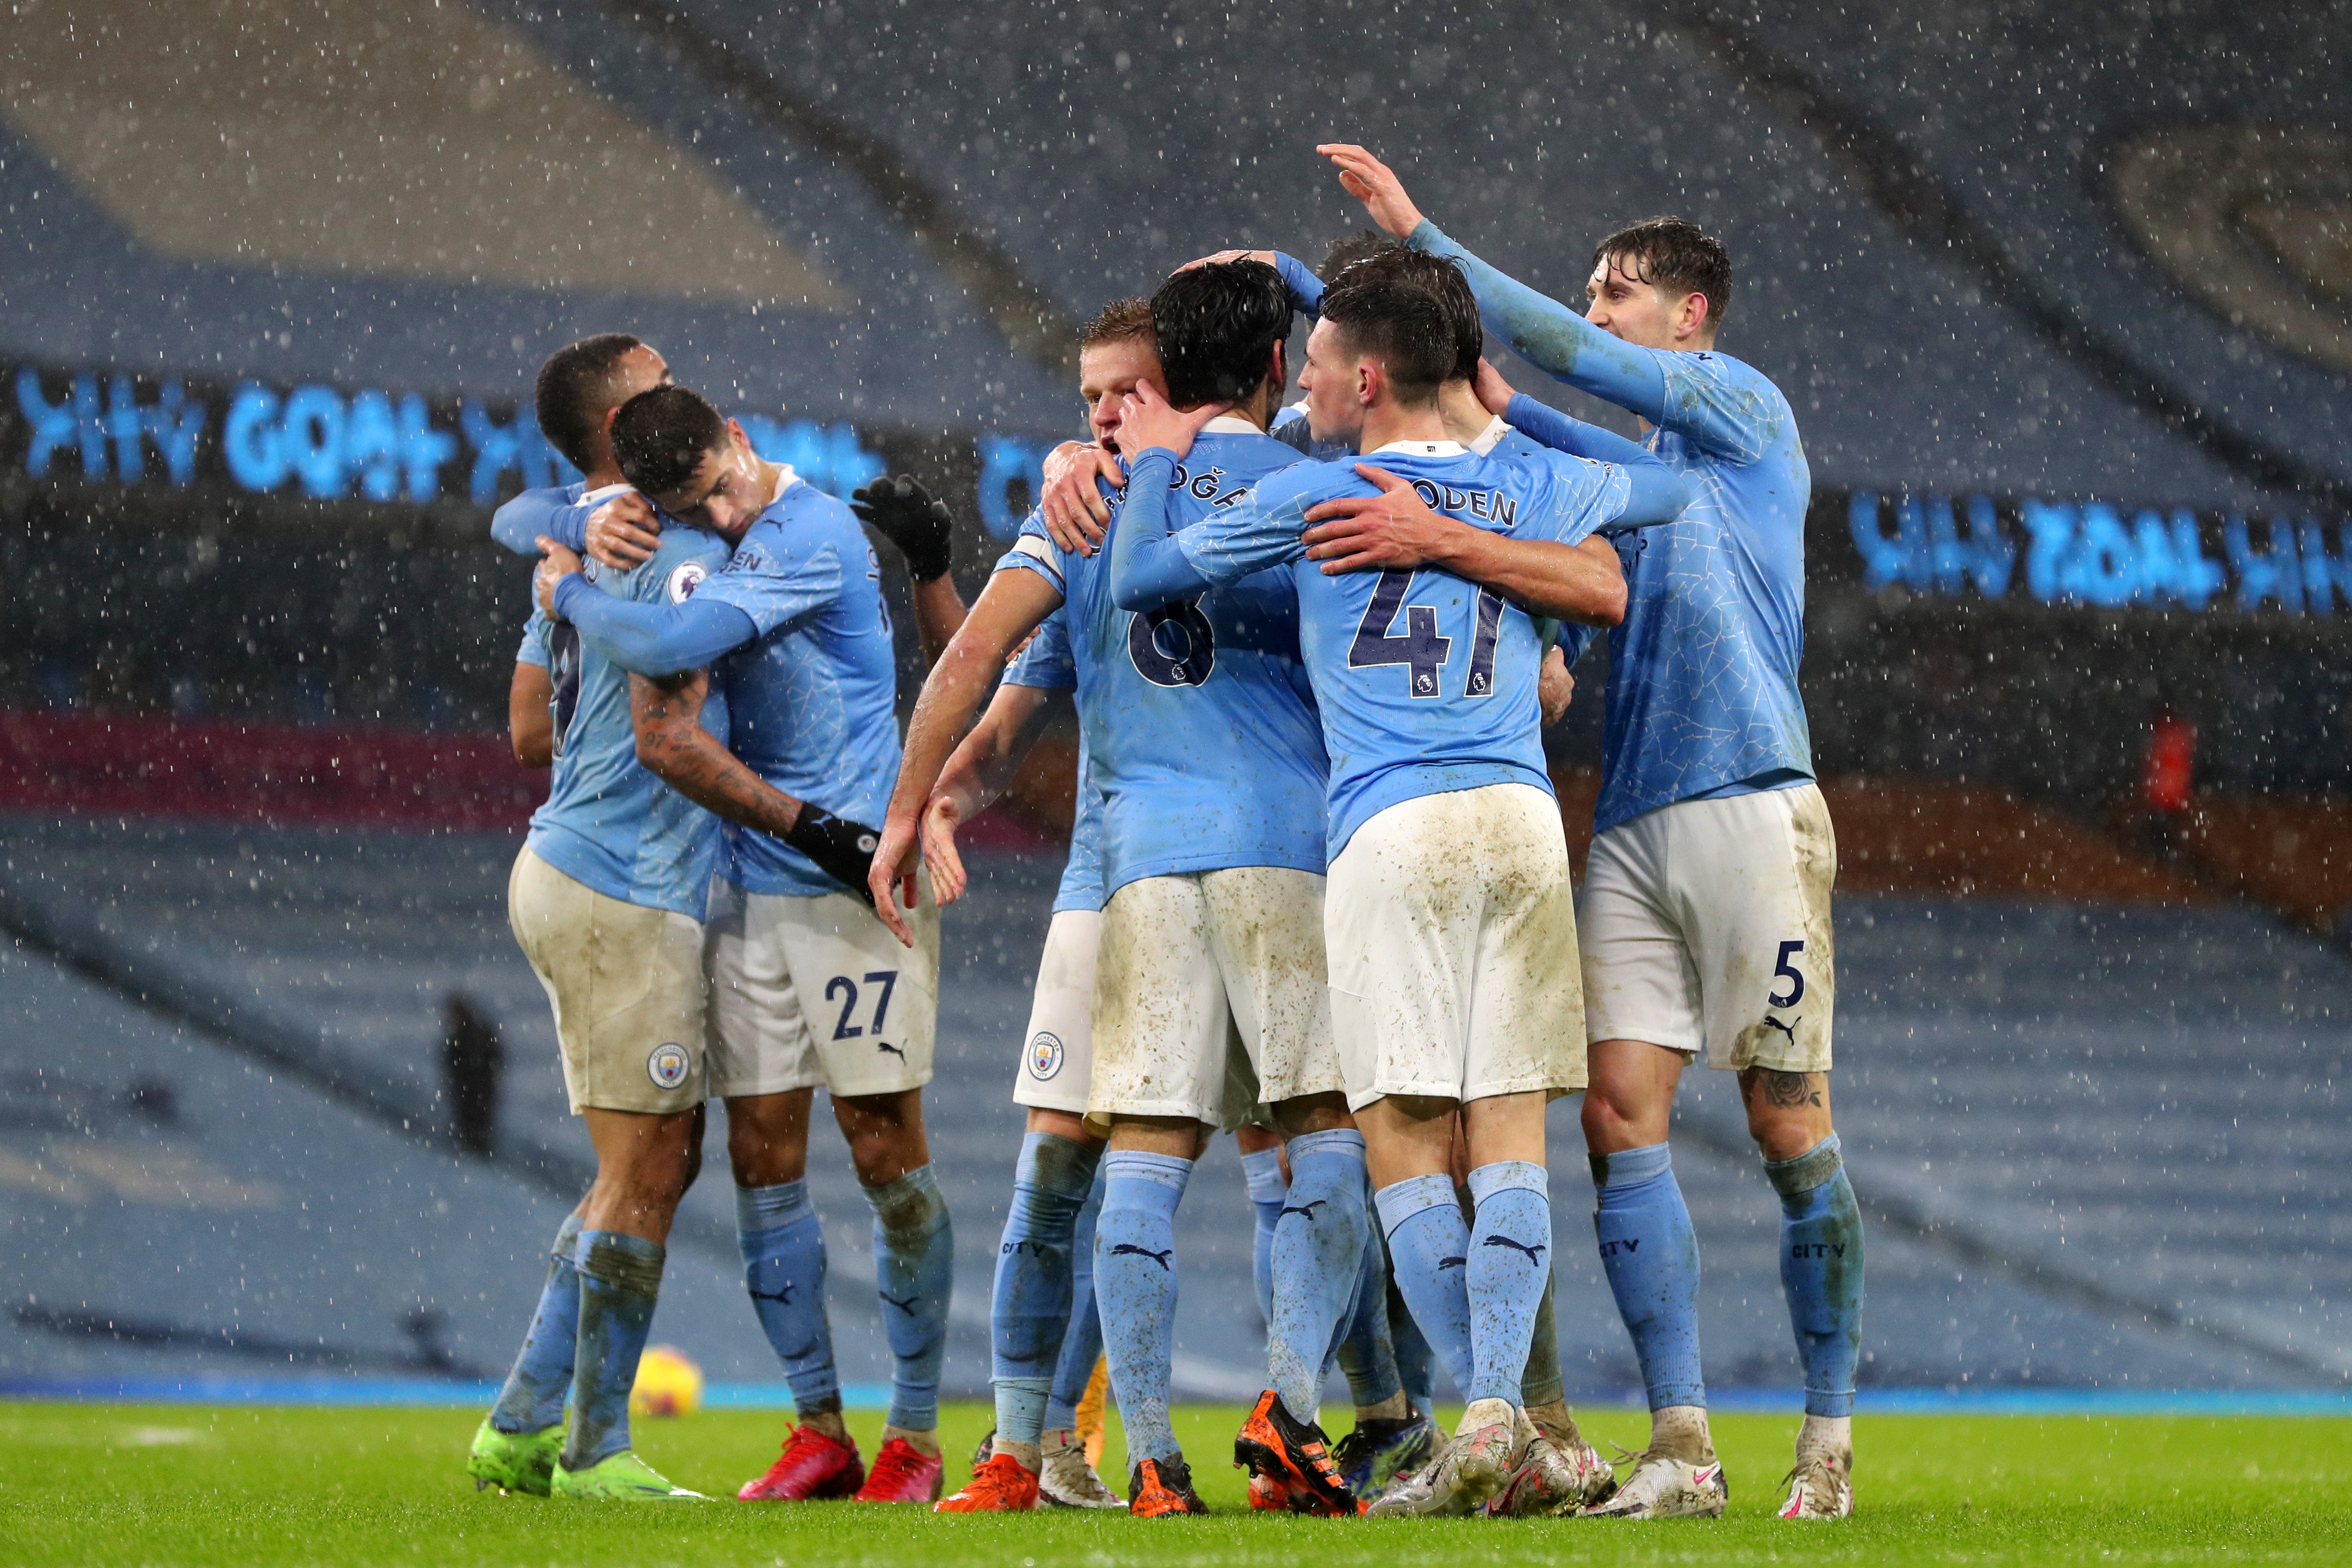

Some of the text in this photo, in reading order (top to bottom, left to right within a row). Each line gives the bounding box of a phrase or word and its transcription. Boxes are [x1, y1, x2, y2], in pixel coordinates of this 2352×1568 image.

[1411, 478, 1517, 528] ODEN
[1768, 940, 1805, 1008] 5
[825, 970, 898, 1041] 27
[1033, 1035, 1060, 1052] MANCHESTER
[1003, 1242, 1046, 1257] CITY
[1792, 1243, 1846, 1258] CITY
